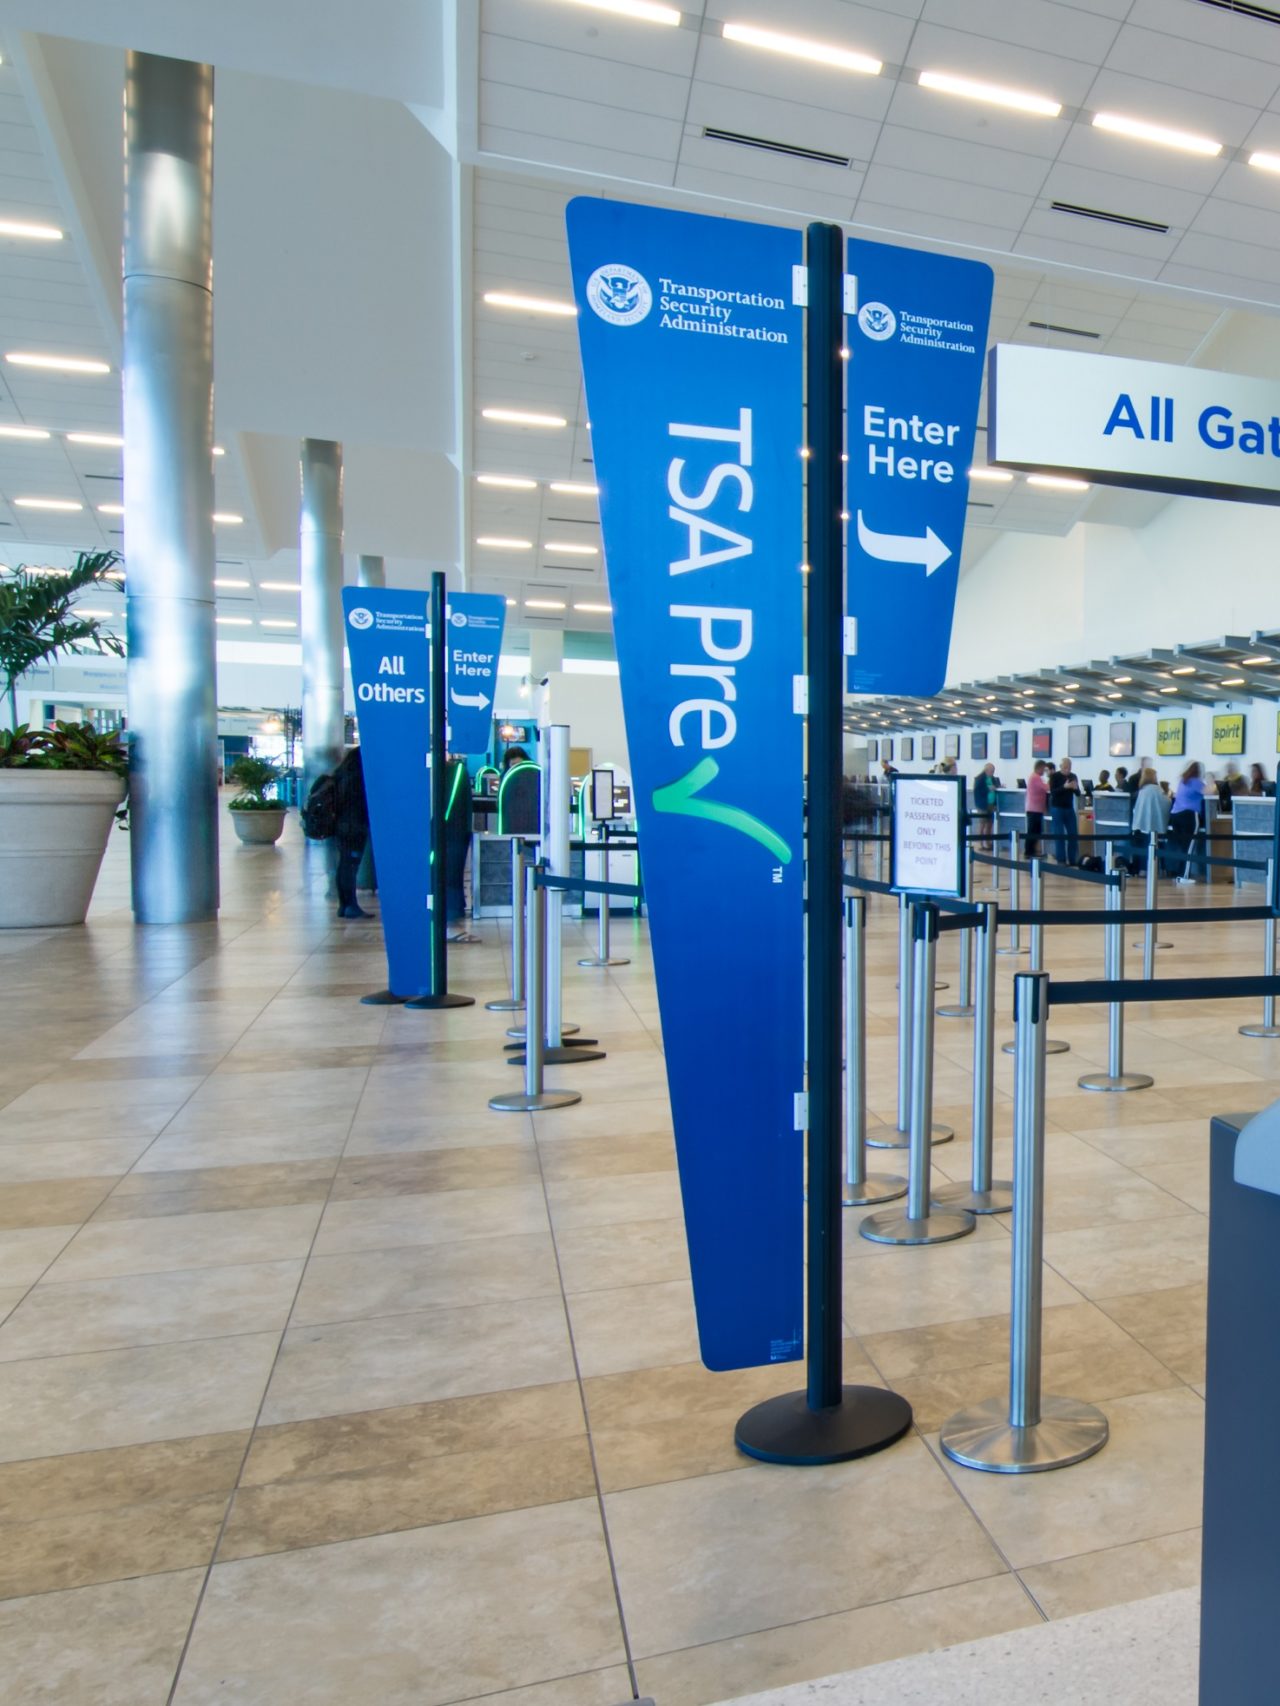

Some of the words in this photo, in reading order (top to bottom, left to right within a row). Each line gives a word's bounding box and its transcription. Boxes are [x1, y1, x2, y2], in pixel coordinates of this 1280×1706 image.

[658, 277, 786, 311] Transportation
[659, 296, 733, 323] Security
[659, 313, 789, 344] Administration
[899, 310, 974, 333] Transportation
[900, 322, 942, 340] Security
[900, 333, 976, 354] Administration
[863, 404, 961, 447] Enter
[1102, 393, 1175, 444] All
[867, 443, 955, 484] Here
[667, 407, 754, 577] TSA
[375, 611, 424, 621] Transportation
[375, 623, 425, 633] Administration
[378, 655, 406, 676] All
[452, 649, 494, 663] Enter
[455, 664, 492, 677] Here
[668, 604, 753, 749] Pre
[357, 682, 426, 704] Others
[1158, 727, 1181, 744] spirit
[1214, 723, 1240, 743] spirit
[910, 797, 944, 807] TICKETED
[904, 811, 951, 822] PASSENGERS
[916, 826, 936, 836] ONLY
[903, 840, 933, 850] BEYOND
[934, 842, 951, 852] THIS
[915, 856, 938, 866] POINT
